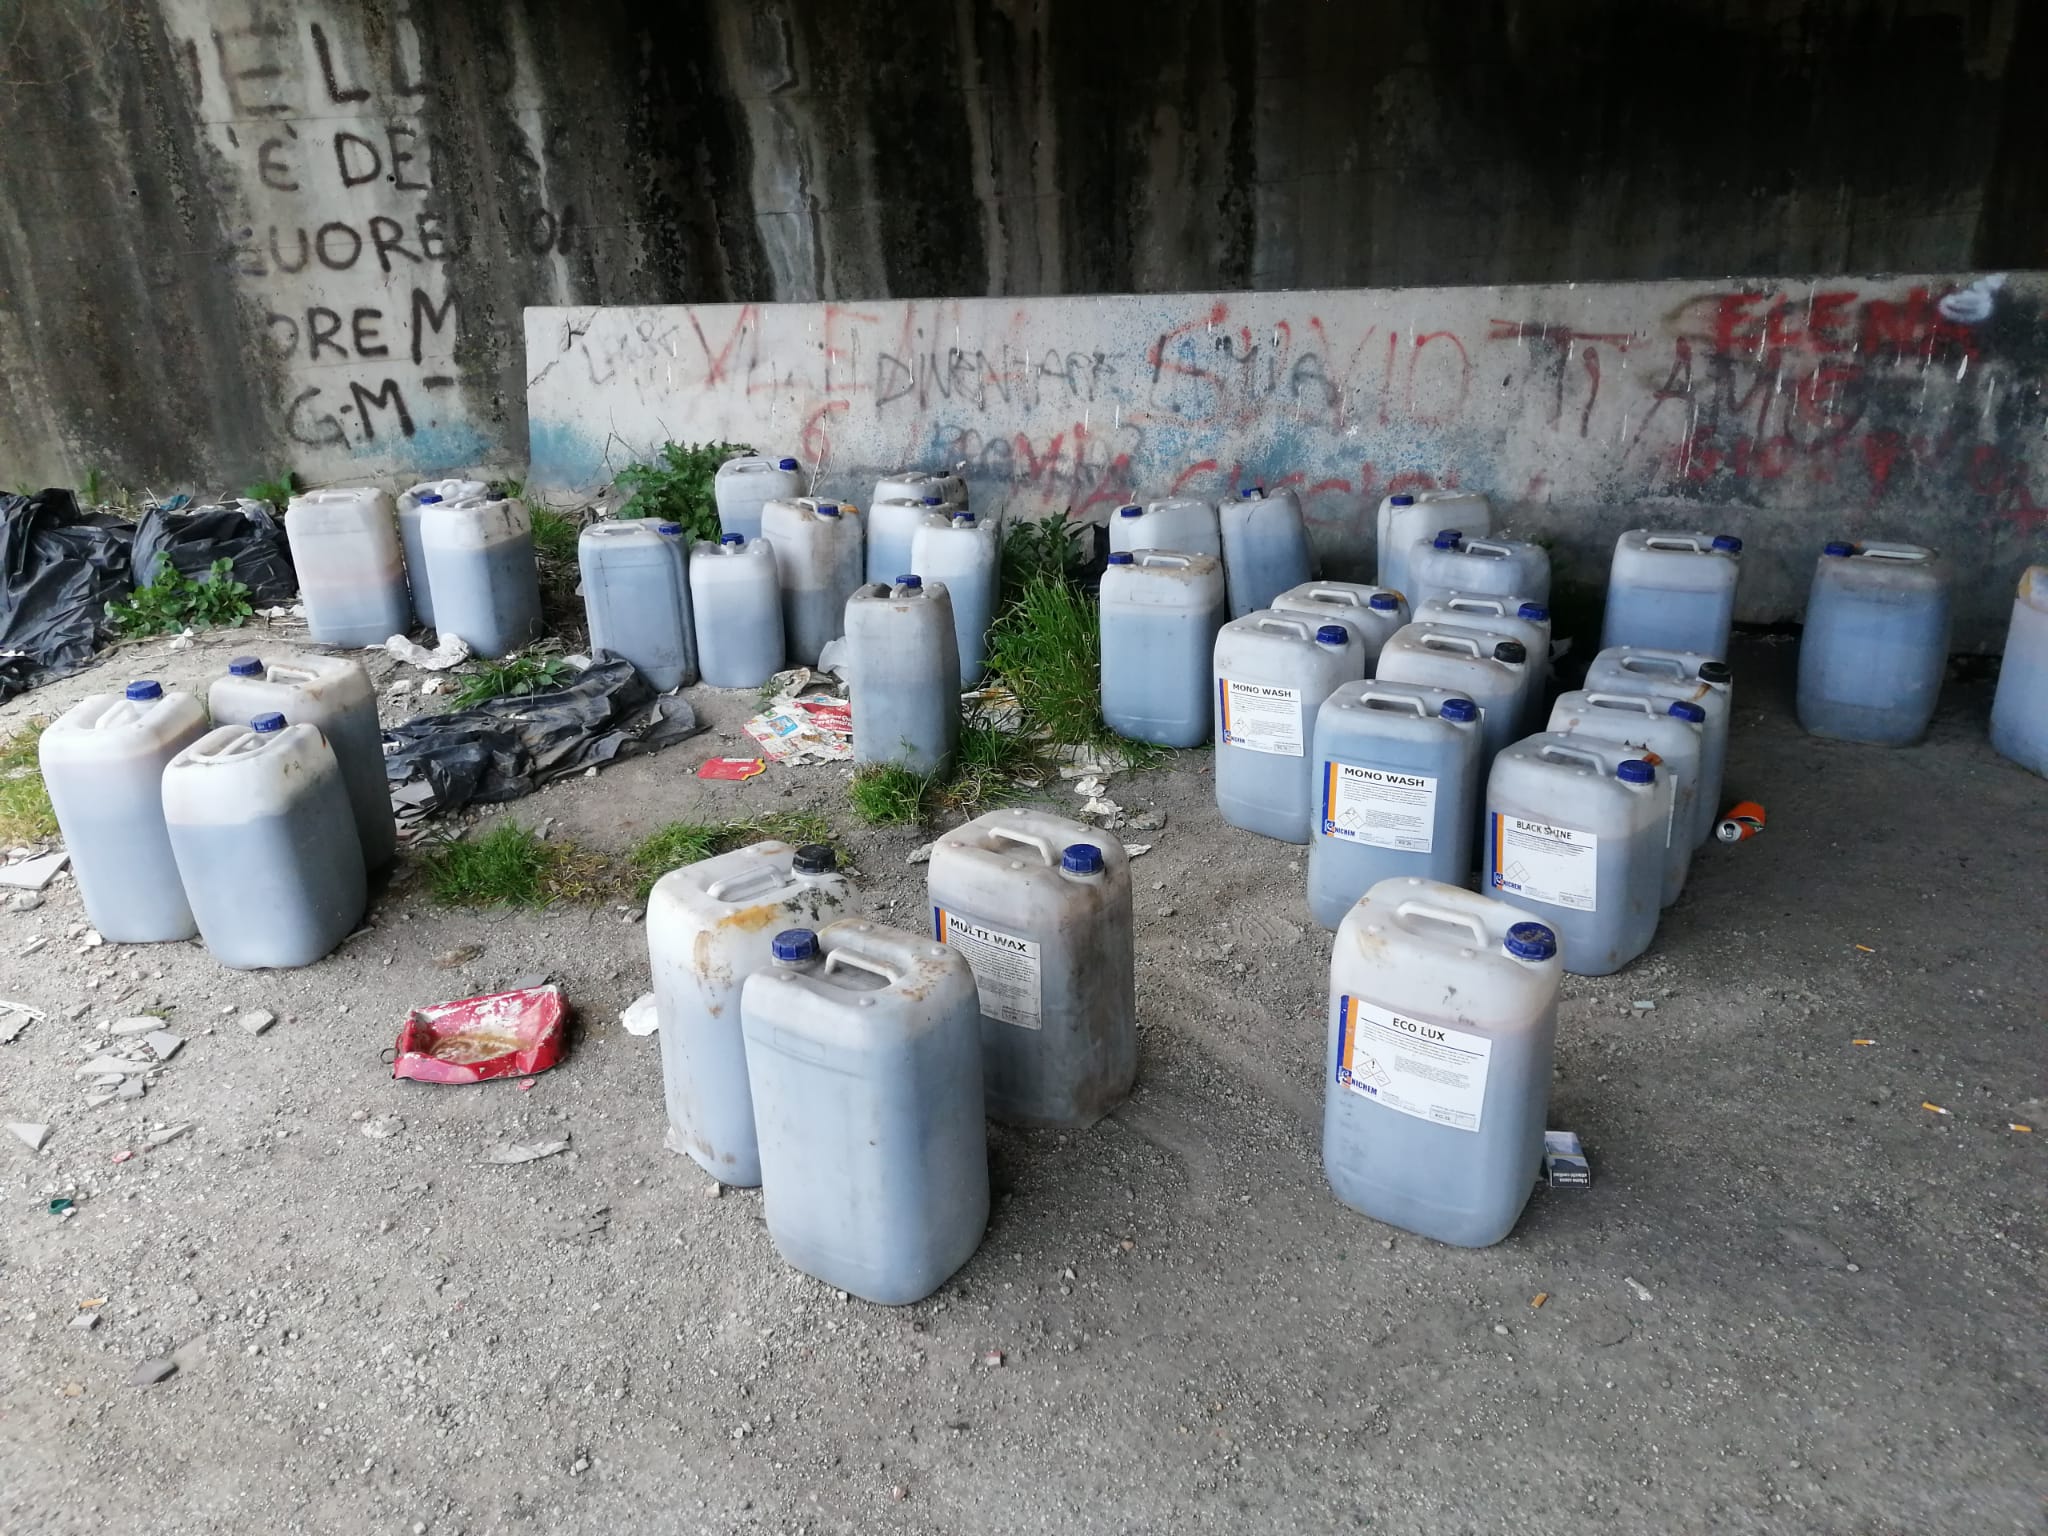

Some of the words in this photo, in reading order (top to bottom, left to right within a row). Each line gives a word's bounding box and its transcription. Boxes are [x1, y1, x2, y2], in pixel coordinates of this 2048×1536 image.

[1232, 683, 1259, 694] MONO
[1262, 688, 1292, 698] WASH
[1344, 767, 1382, 781] MONO
[1386, 774, 1425, 787] WASH
[1516, 820, 1542, 833] BLACK
[1544, 826, 1572, 840] SHINE
[950, 918, 989, 941] MULTI
[993, 934, 1027, 953] WAX
[1392, 1017, 1417, 1033] ECO
[1420, 1026, 1446, 1042] LUX
